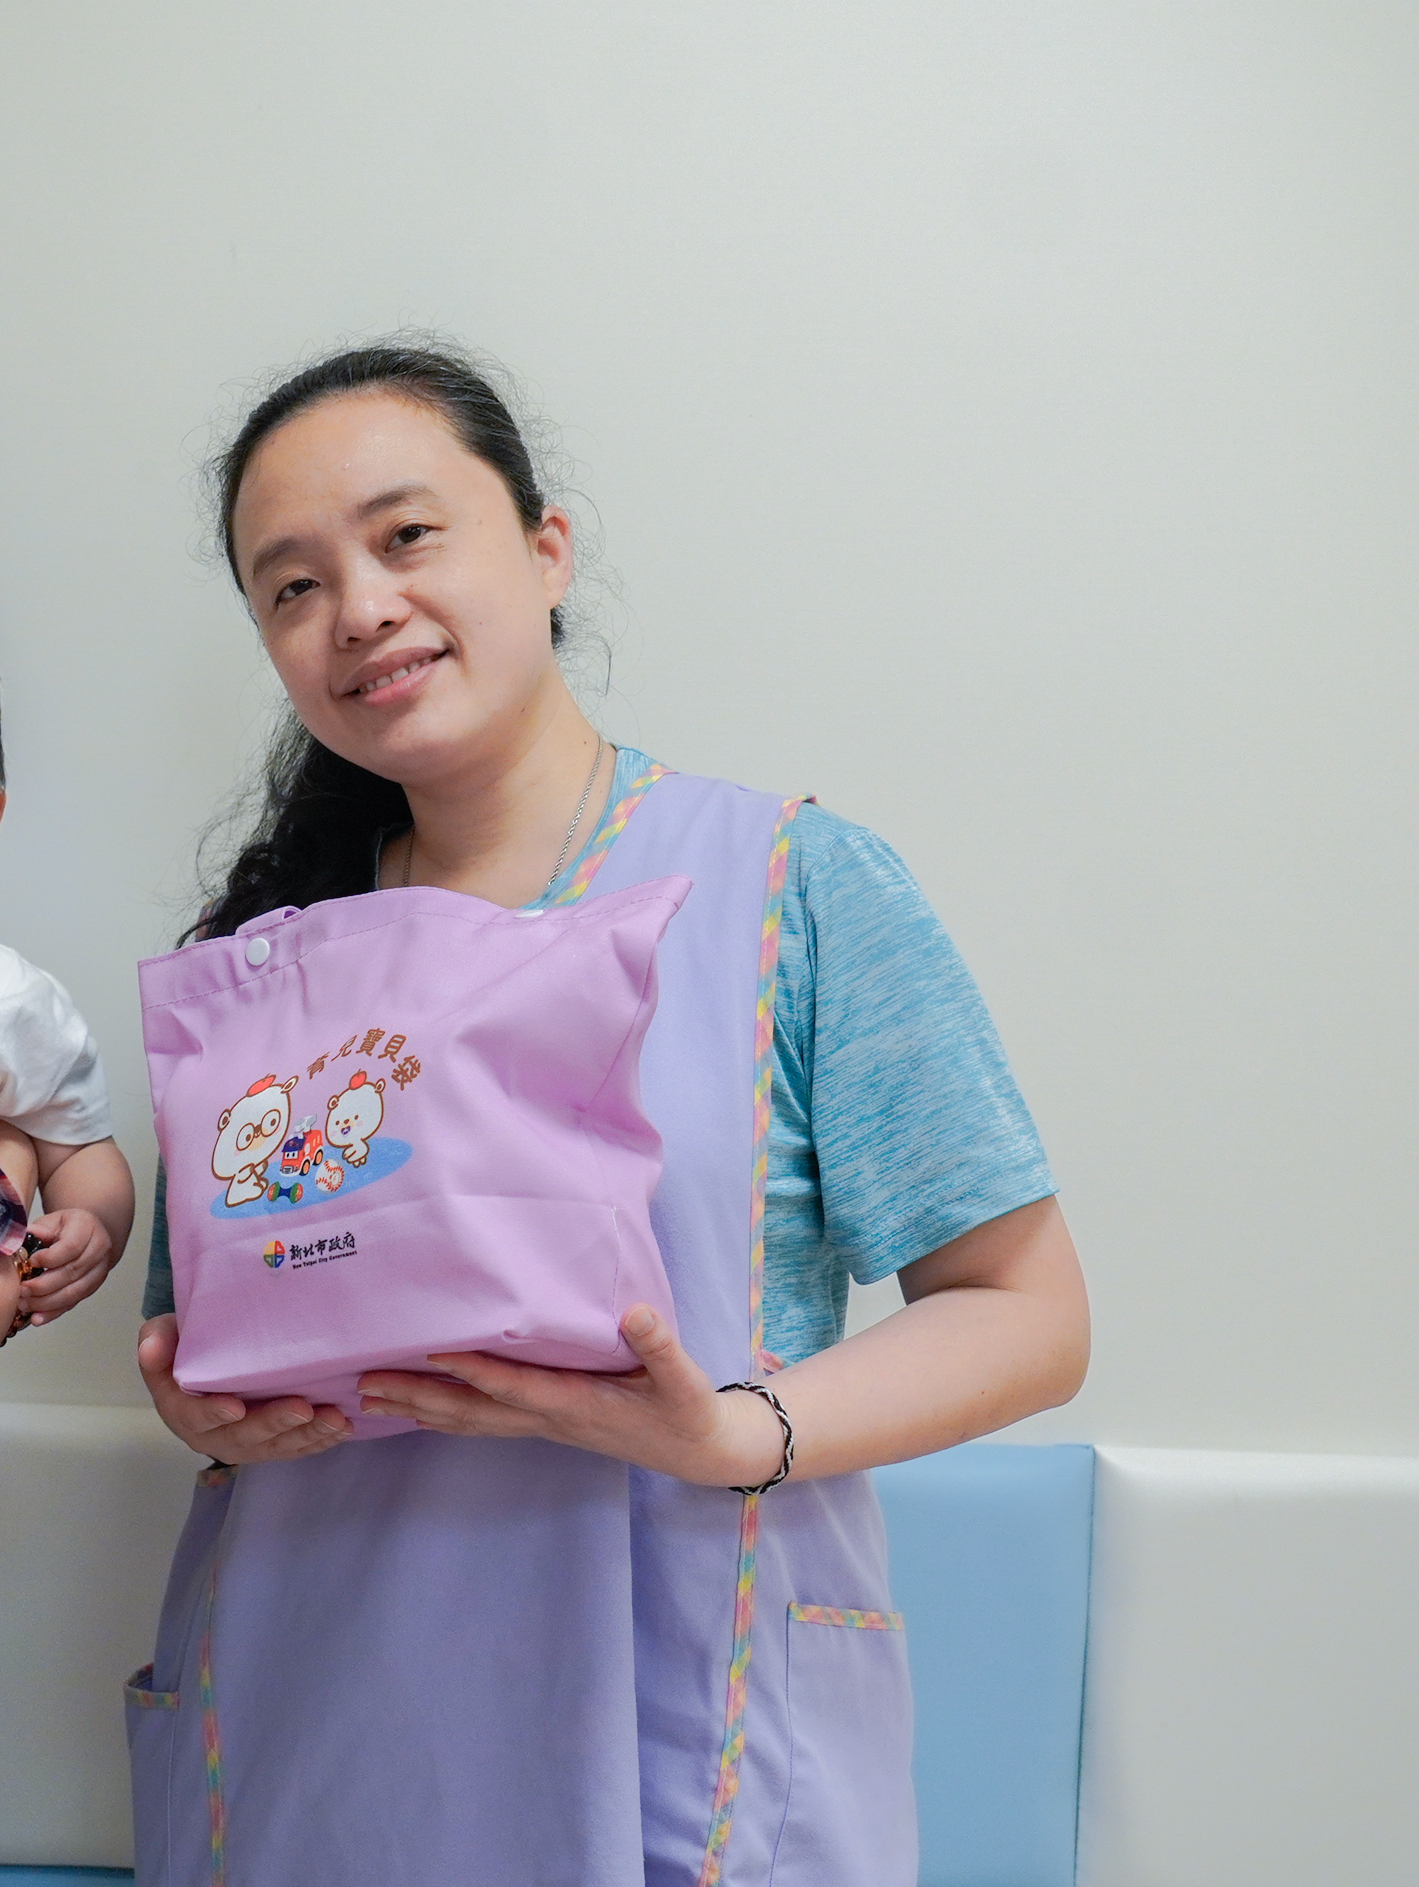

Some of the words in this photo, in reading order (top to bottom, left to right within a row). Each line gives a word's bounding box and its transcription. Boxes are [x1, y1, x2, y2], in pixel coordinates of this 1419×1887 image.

[289, 1231, 355, 1260] 新北市政府
